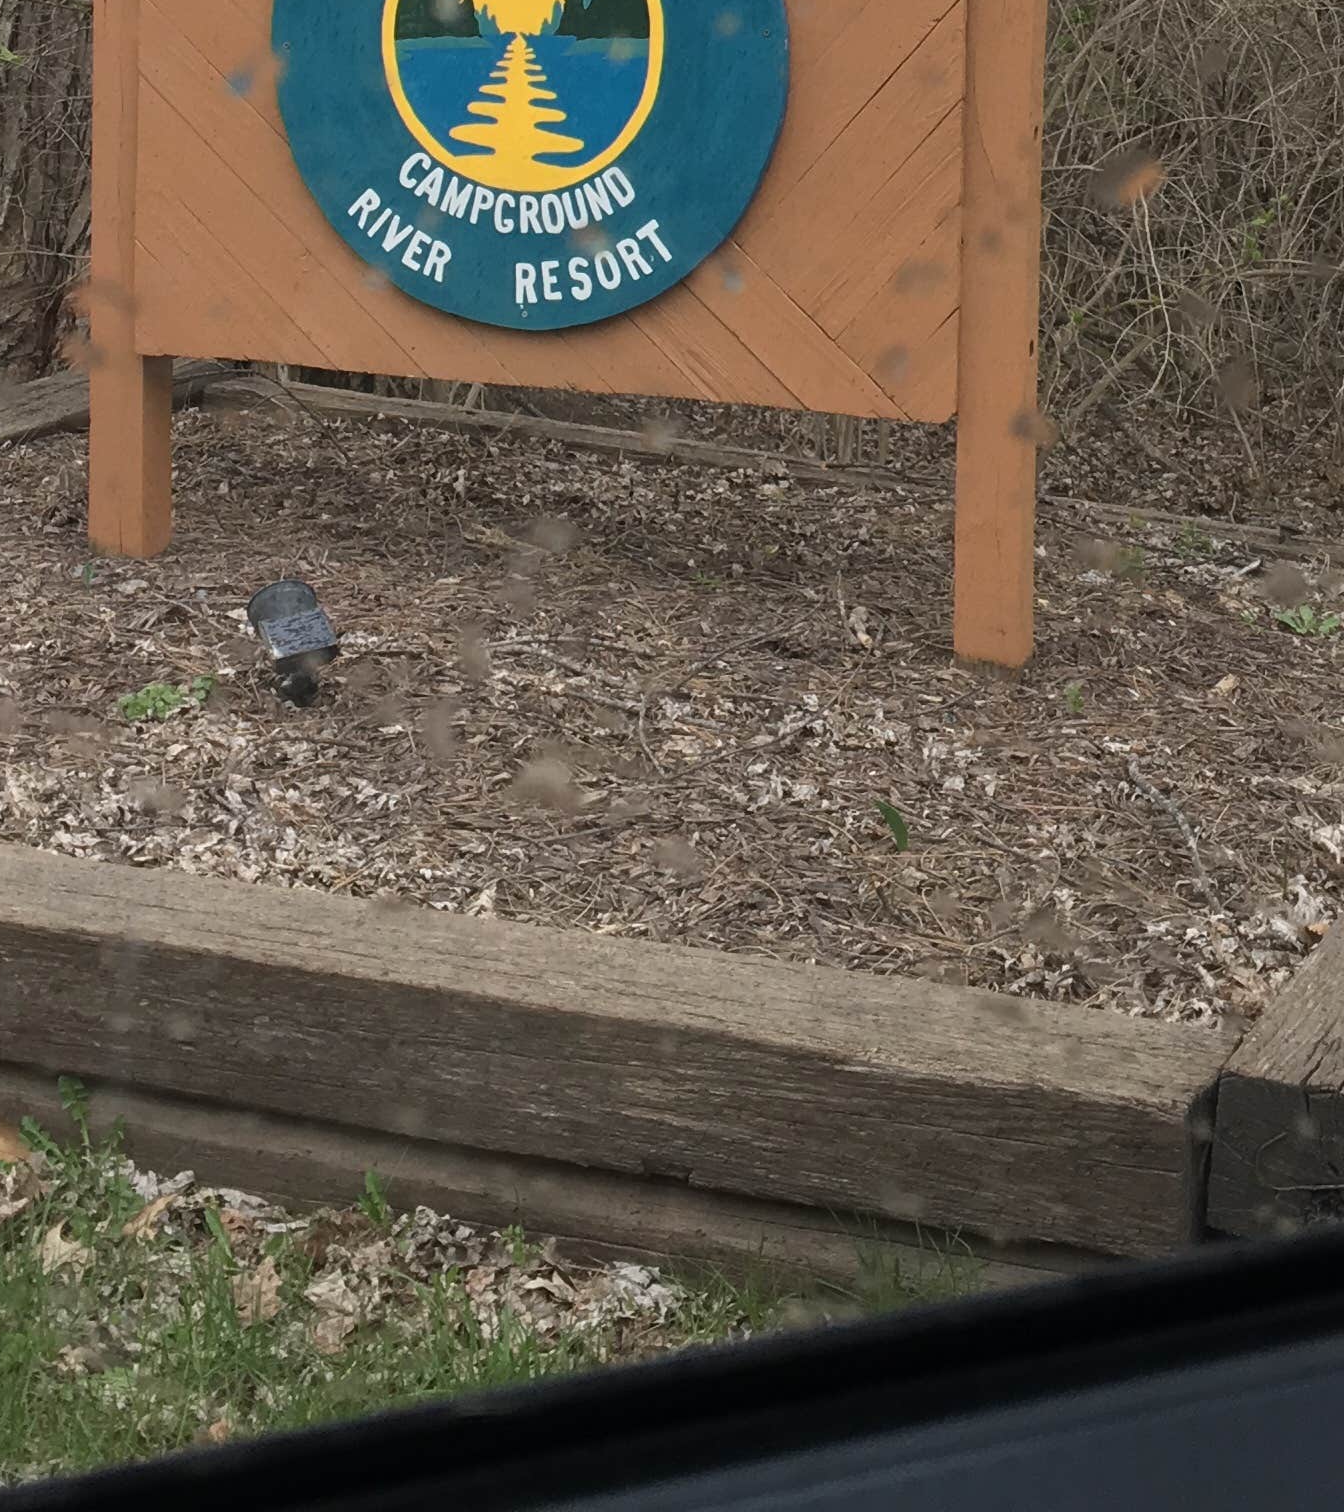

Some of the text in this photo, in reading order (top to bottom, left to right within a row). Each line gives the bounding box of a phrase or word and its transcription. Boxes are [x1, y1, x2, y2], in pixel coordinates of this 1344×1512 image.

[398, 152, 635, 234] CAMPGROUND
[348, 188, 673, 304] RIVER RESORT
